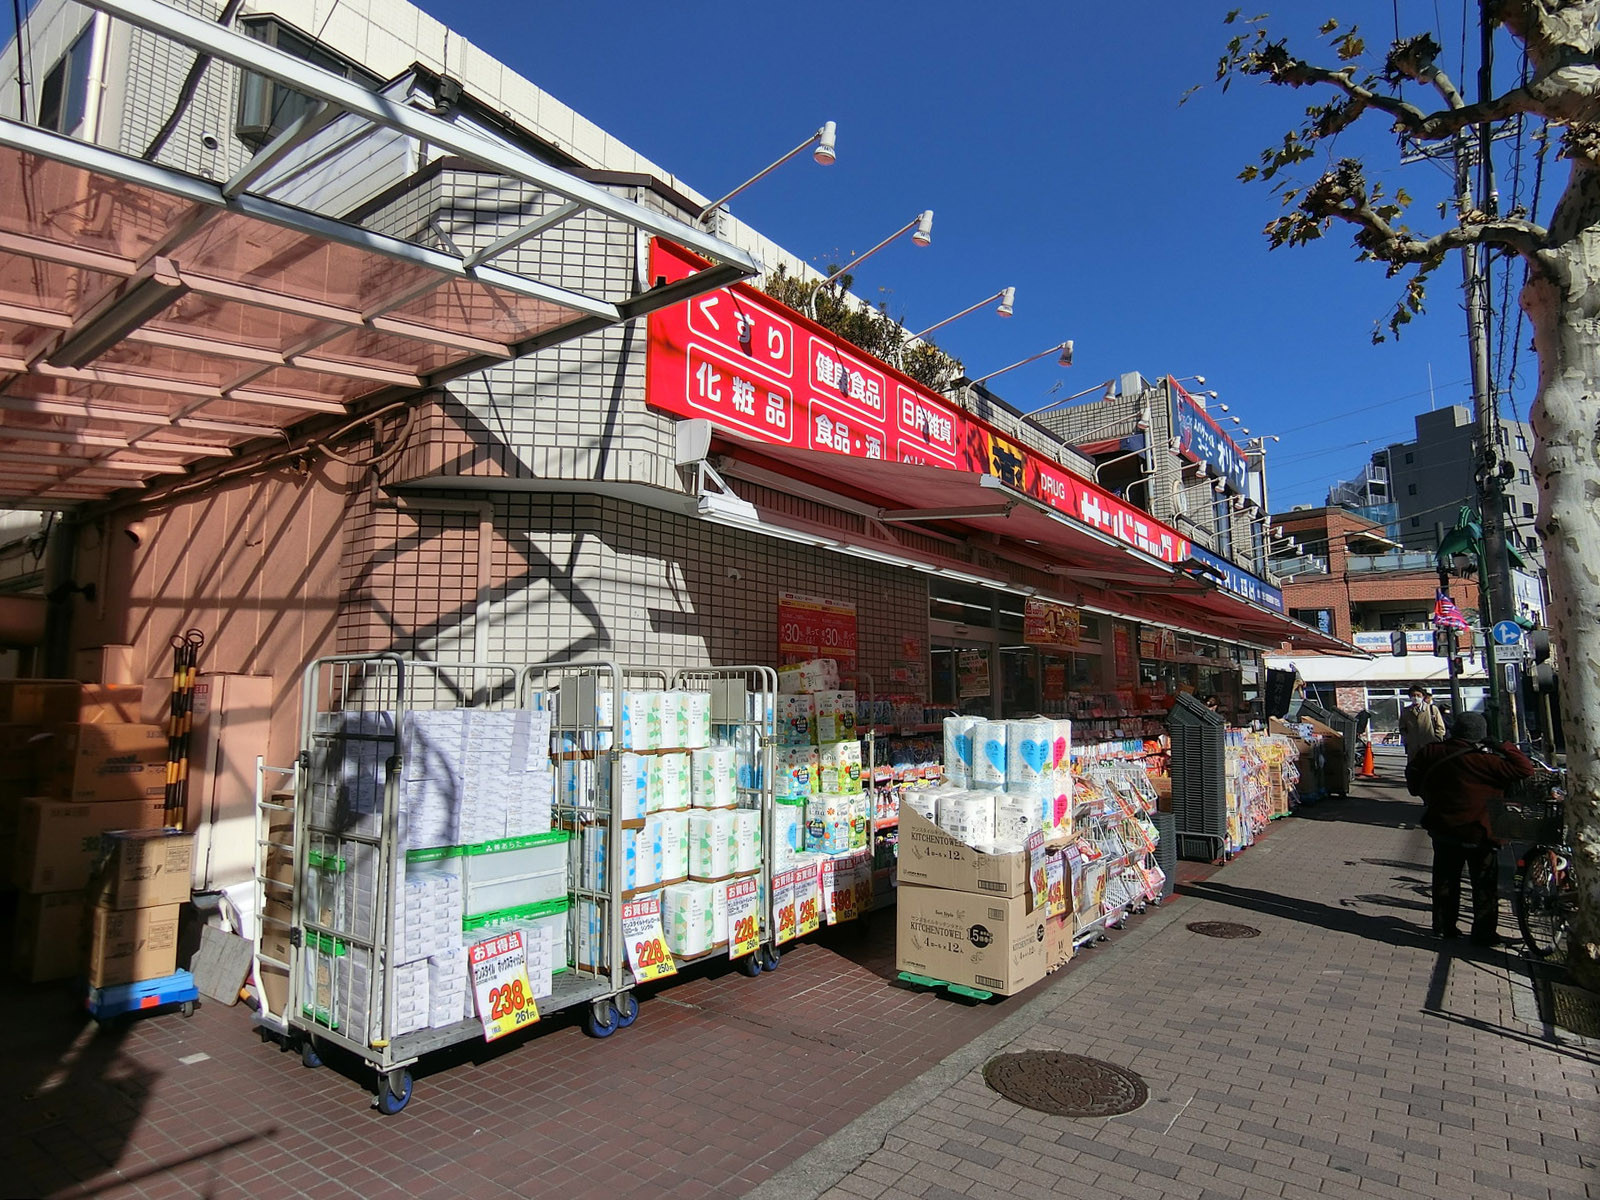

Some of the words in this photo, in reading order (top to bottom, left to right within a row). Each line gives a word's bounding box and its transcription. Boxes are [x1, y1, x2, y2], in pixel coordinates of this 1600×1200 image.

[699, 297, 785, 360] くすり
[815, 351, 881, 410] 健康食品
[696, 361, 786, 428] 化粧品
[1041, 473, 1065, 500] DRUG
[911, 832, 965, 848] KITCHENTOWEL
[729, 880, 756, 899] お買得品
[624, 901, 658, 917] お買得品
[910, 922, 965, 940] KITCHENTOWEL
[474, 934, 520, 960] お買得品
